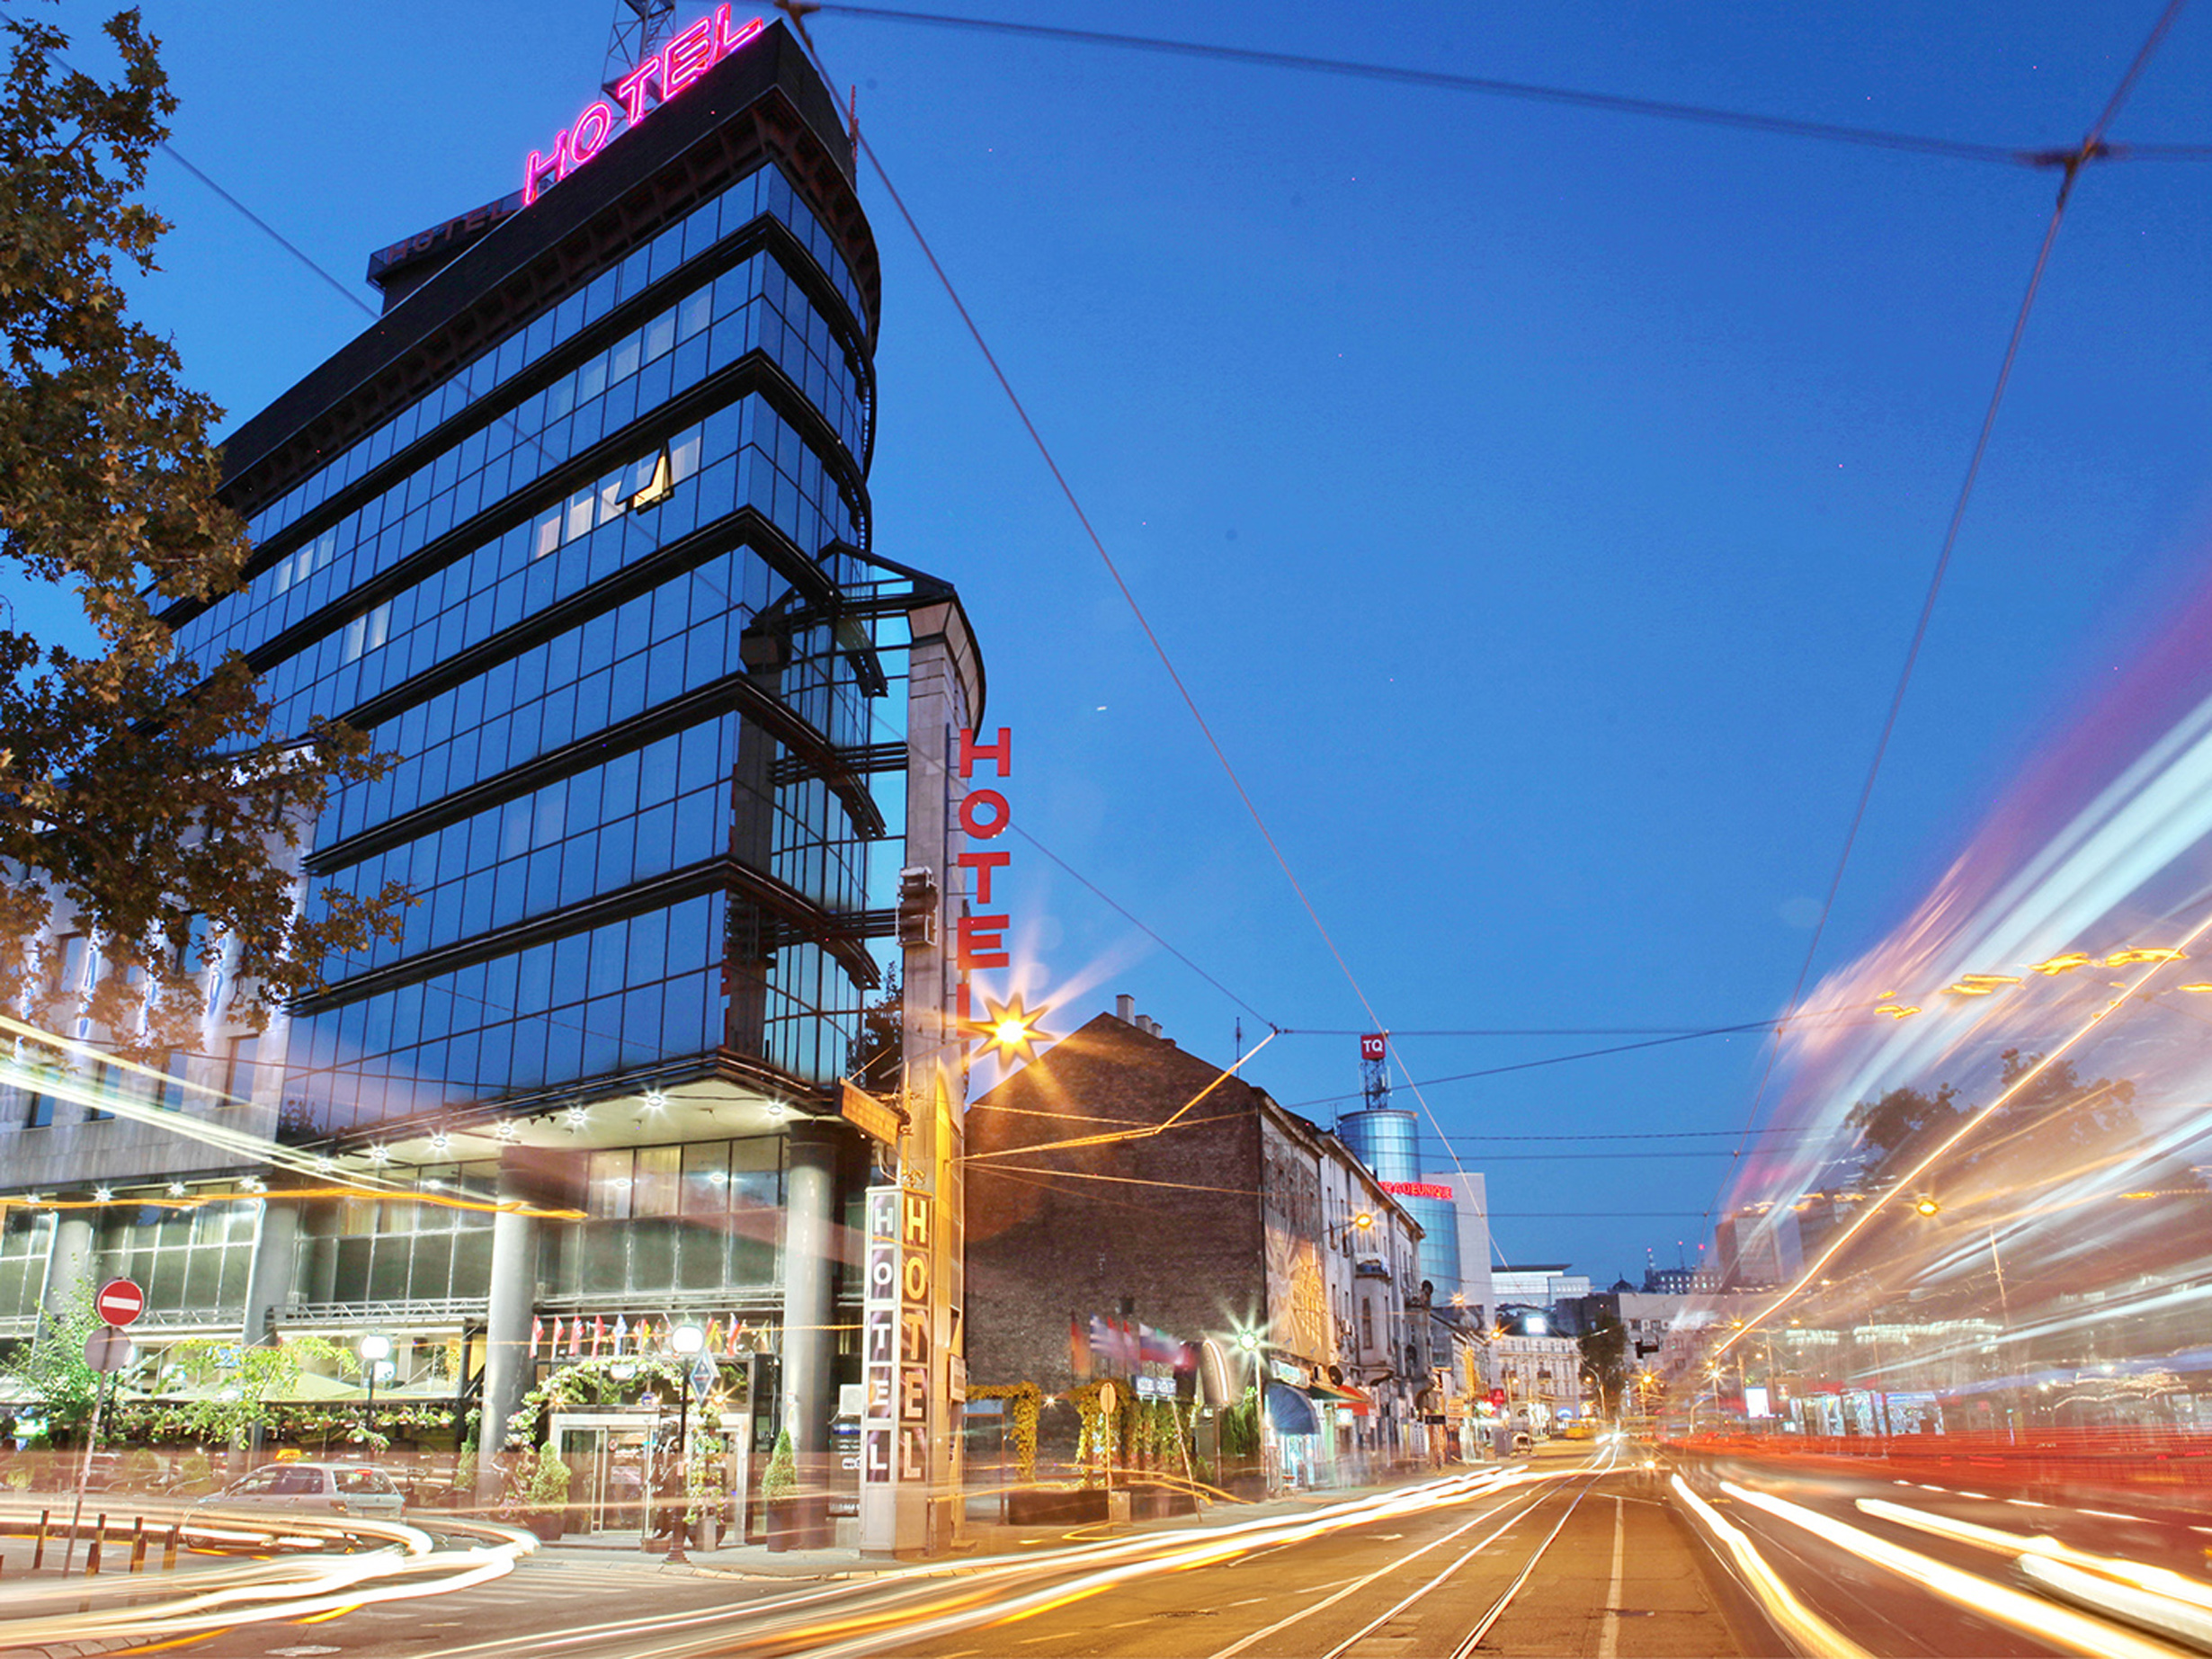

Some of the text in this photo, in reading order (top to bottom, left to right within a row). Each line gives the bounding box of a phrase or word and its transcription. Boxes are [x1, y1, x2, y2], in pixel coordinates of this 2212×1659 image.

[522, 4, 763, 206] HOTEL
[388, 201, 513, 265] HOTEL
[957, 727, 1011, 1038] HOTEL
[1363, 1039, 1383, 1052] TQ
[870, 1208, 894, 1470] HOTEL
[904, 1197, 927, 1479] HOTEL
